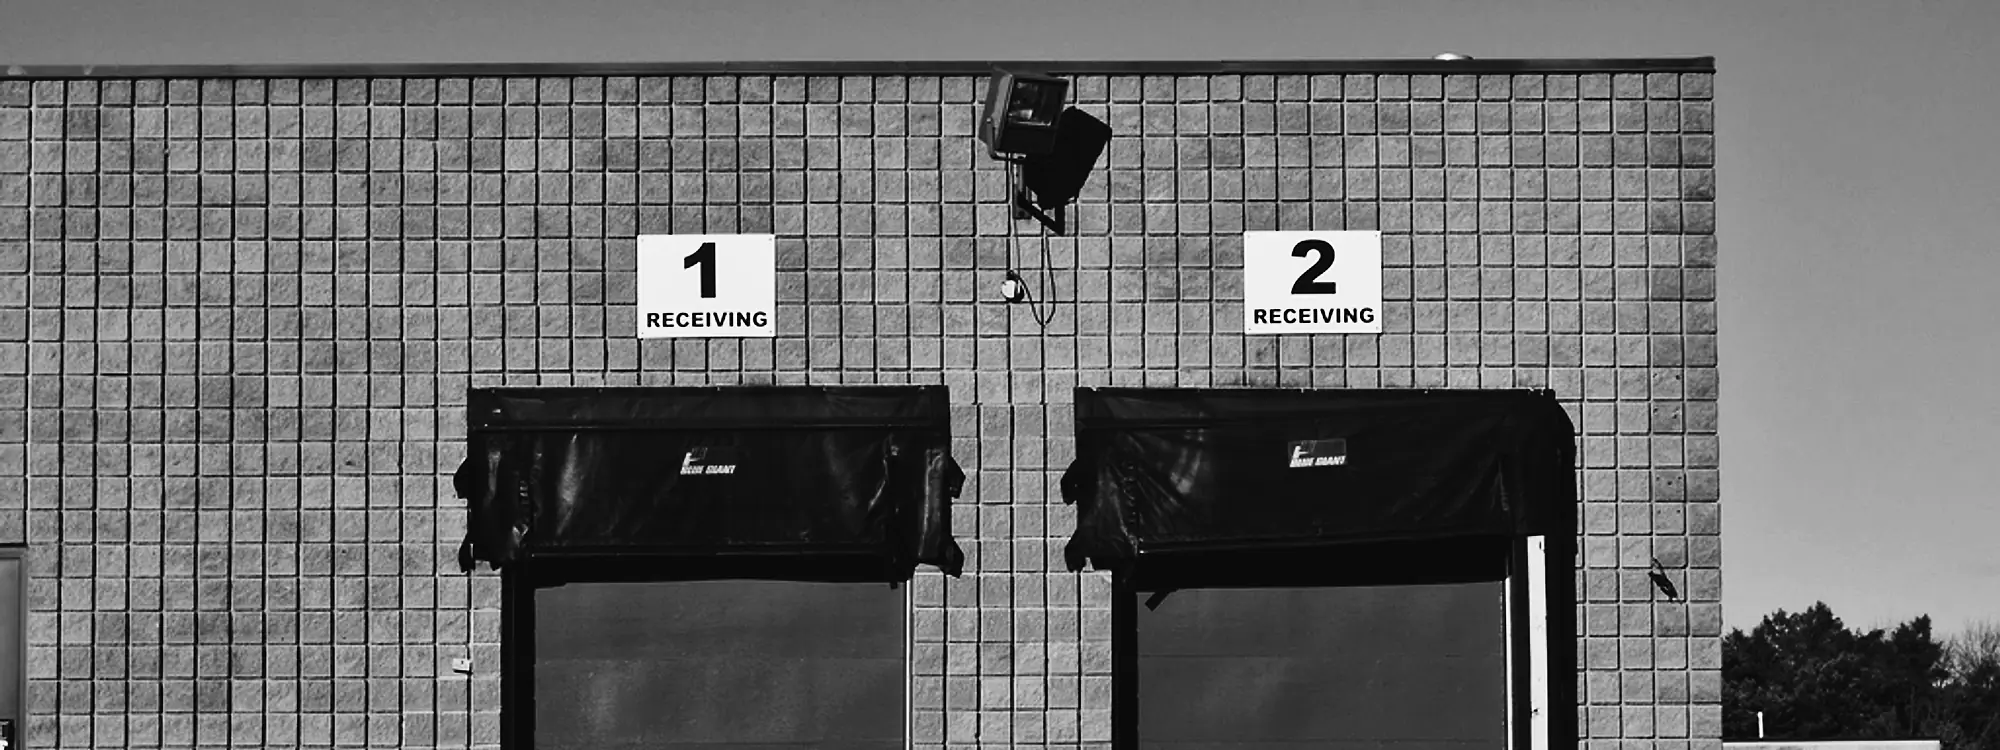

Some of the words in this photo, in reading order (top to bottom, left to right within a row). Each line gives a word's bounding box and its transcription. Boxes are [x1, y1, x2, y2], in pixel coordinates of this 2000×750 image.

[683, 242, 716, 298] 1
[1290, 239, 1336, 294] 2
[646, 311, 768, 328] RECEIVING
[1253, 307, 1375, 324] RECEIVING
